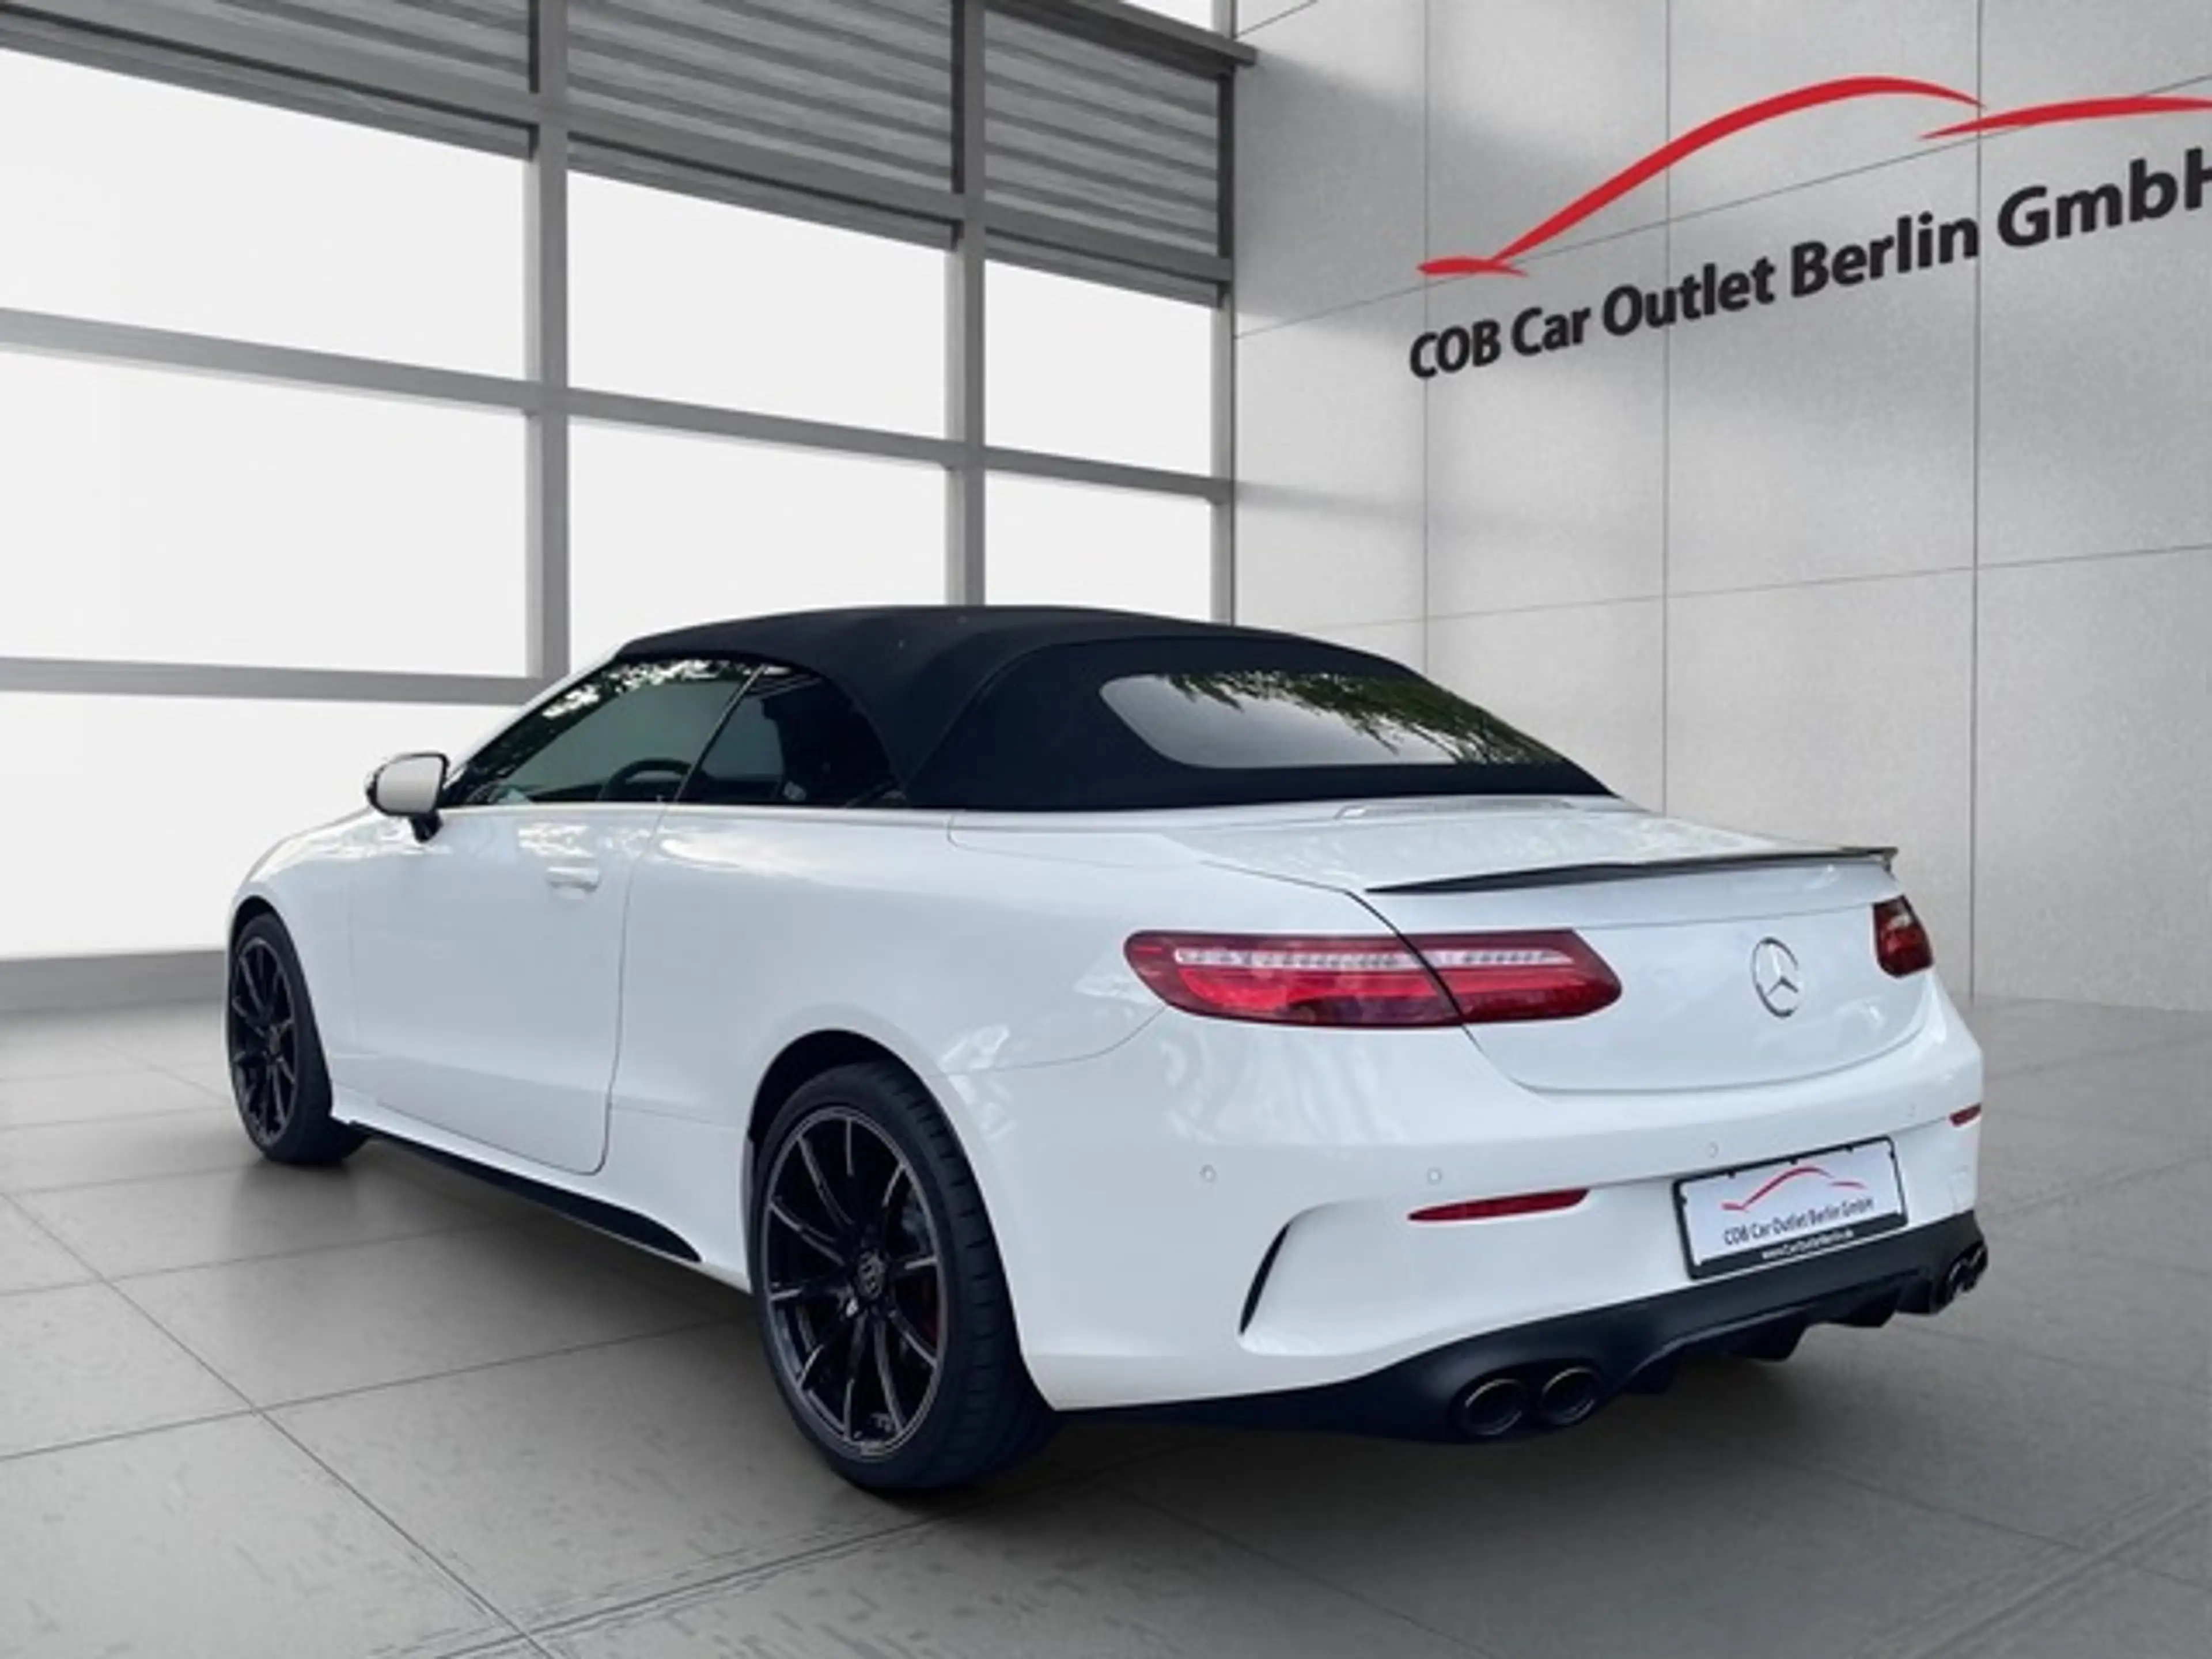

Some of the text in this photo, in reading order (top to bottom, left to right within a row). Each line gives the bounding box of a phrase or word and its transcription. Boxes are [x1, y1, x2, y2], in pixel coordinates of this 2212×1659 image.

[1410, 320, 1501, 378] COB
[1512, 306, 1591, 355] Car
[1602, 256, 1775, 336] Outlet
[1791, 211, 1979, 297] Berlin
[1723, 1196, 1874, 1245] COB Car Outlet Berlin GmbH
